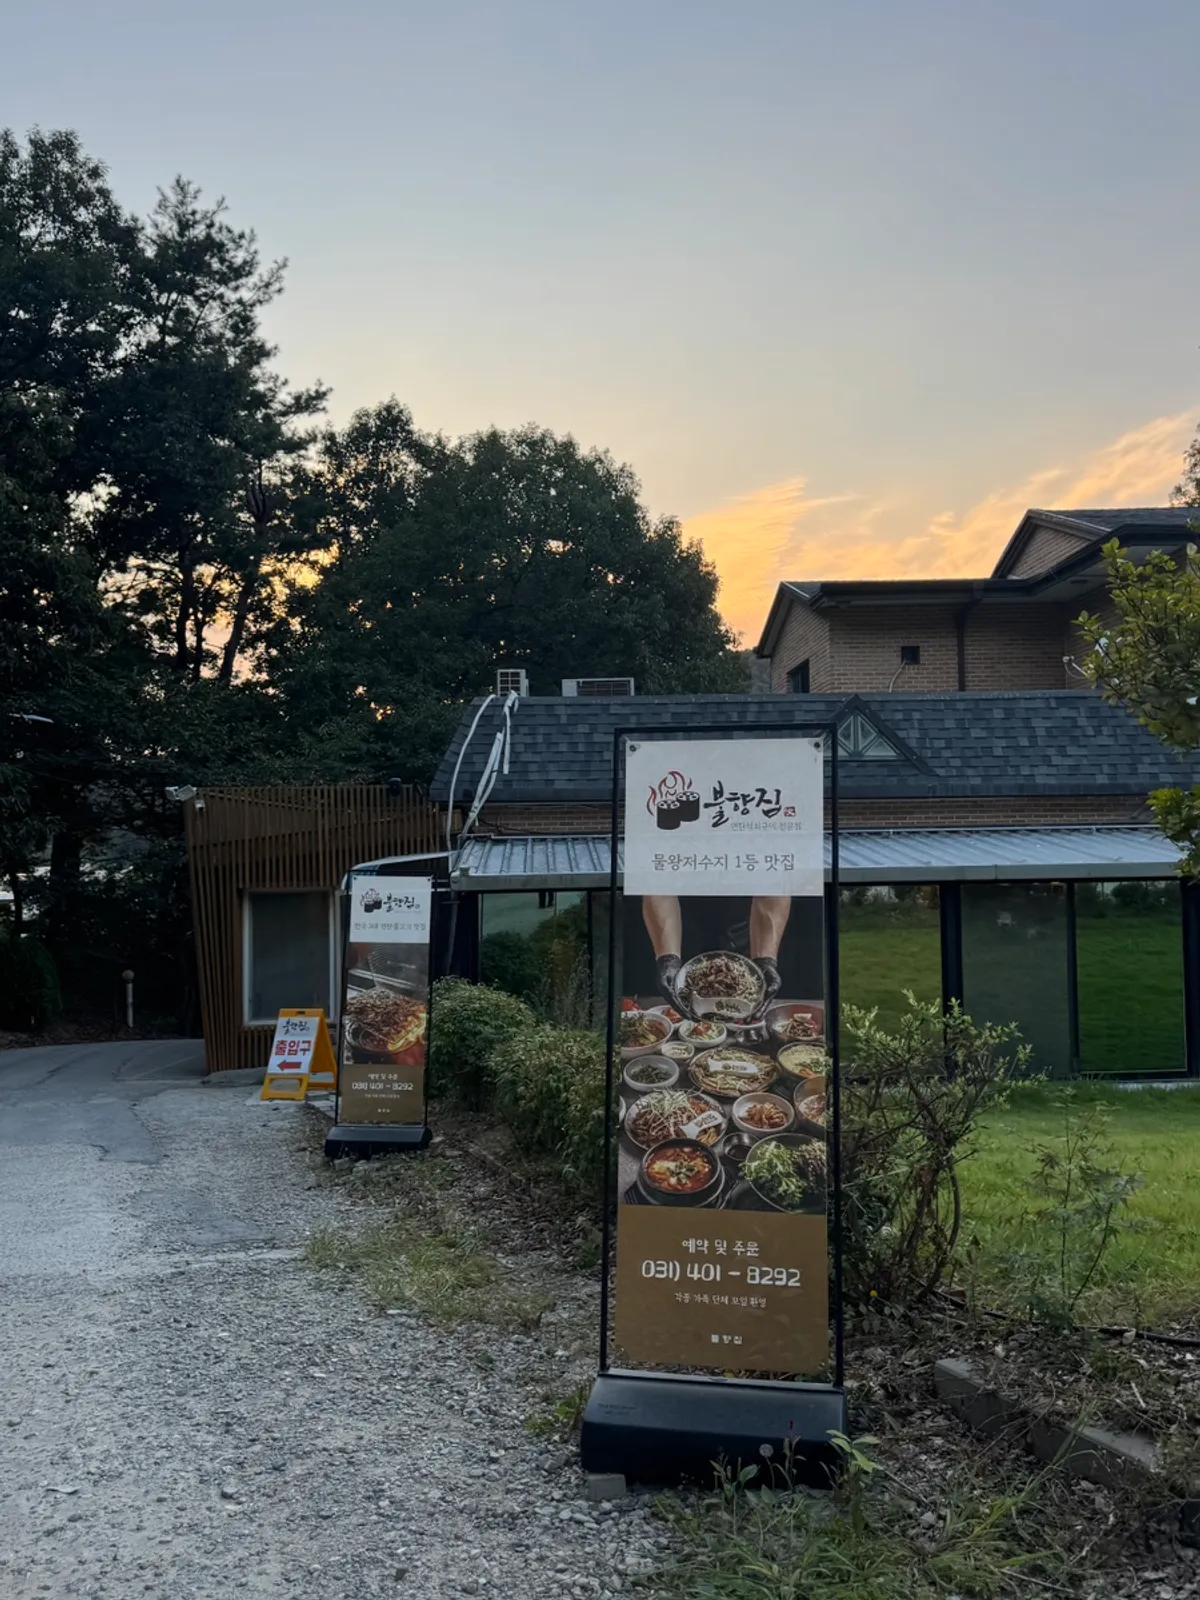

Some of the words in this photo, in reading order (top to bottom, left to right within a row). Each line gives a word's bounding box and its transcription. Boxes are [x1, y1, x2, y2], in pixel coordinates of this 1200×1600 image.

[703, 780, 782, 828] 불향집
[651, 853, 729, 872] 물왕저수지
[735, 854, 759, 872] 1등
[764, 853, 795, 872] 맛집
[274, 1040, 312, 1056] 출입구
[369, 1082, 384, 1090] 401
[392, 1082, 414, 1091] 8292
[682, 1237, 709, 1255] 예약
[714, 1239, 728, 1256] 및
[733, 1240, 760, 1257] 주문
[641, 1259, 681, 1282] 031)
[686, 1262, 721, 1282] 401
[746, 1265, 801, 1287] 8292
[674, 1291, 691, 1304] 각종
[693, 1292, 710, 1305] 가족
[712, 1294, 729, 1306] 단체
[731, 1295, 748, 1307] 모임
[750, 1297, 767, 1308] 환영
